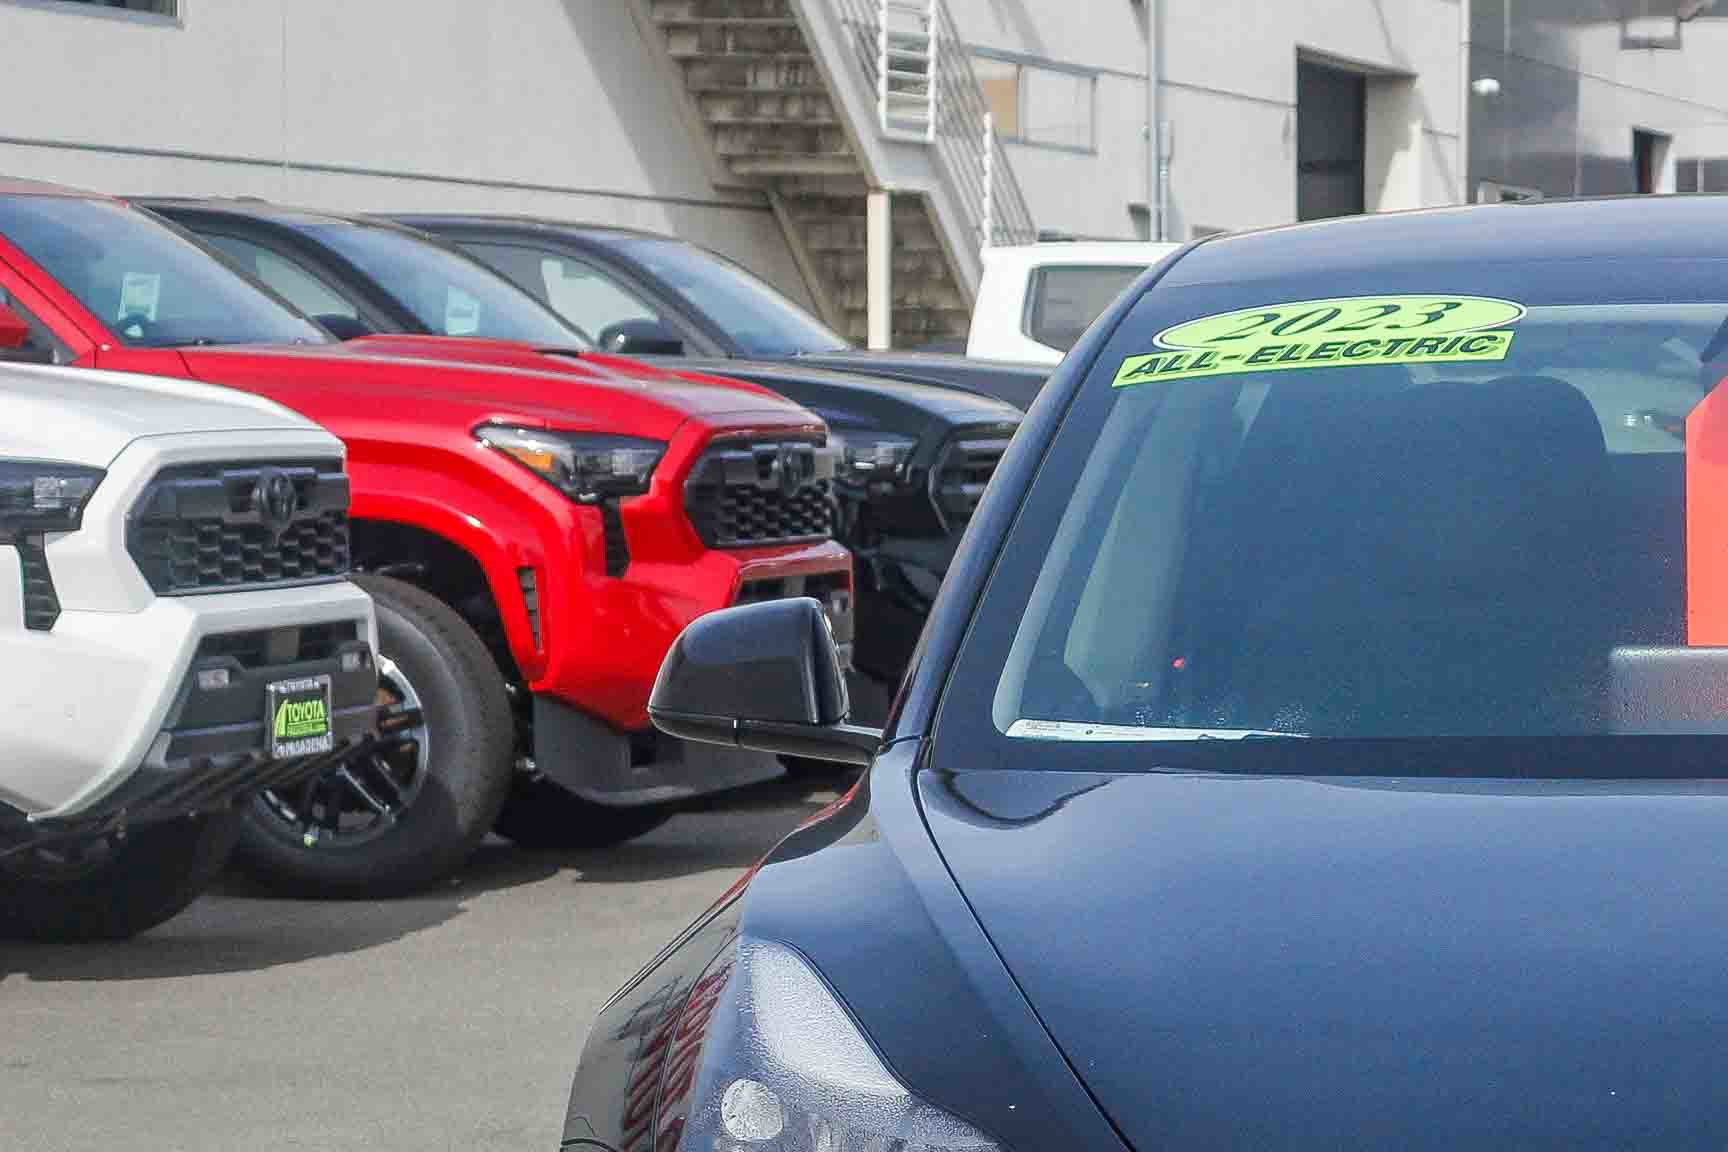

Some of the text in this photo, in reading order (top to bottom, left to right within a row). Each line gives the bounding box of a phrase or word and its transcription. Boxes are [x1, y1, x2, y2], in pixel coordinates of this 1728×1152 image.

[1208, 301, 1462, 344] 2023
[1123, 334, 1505, 380] ALL-ELECTRIC
[287, 700, 325, 721] TOYOTA
